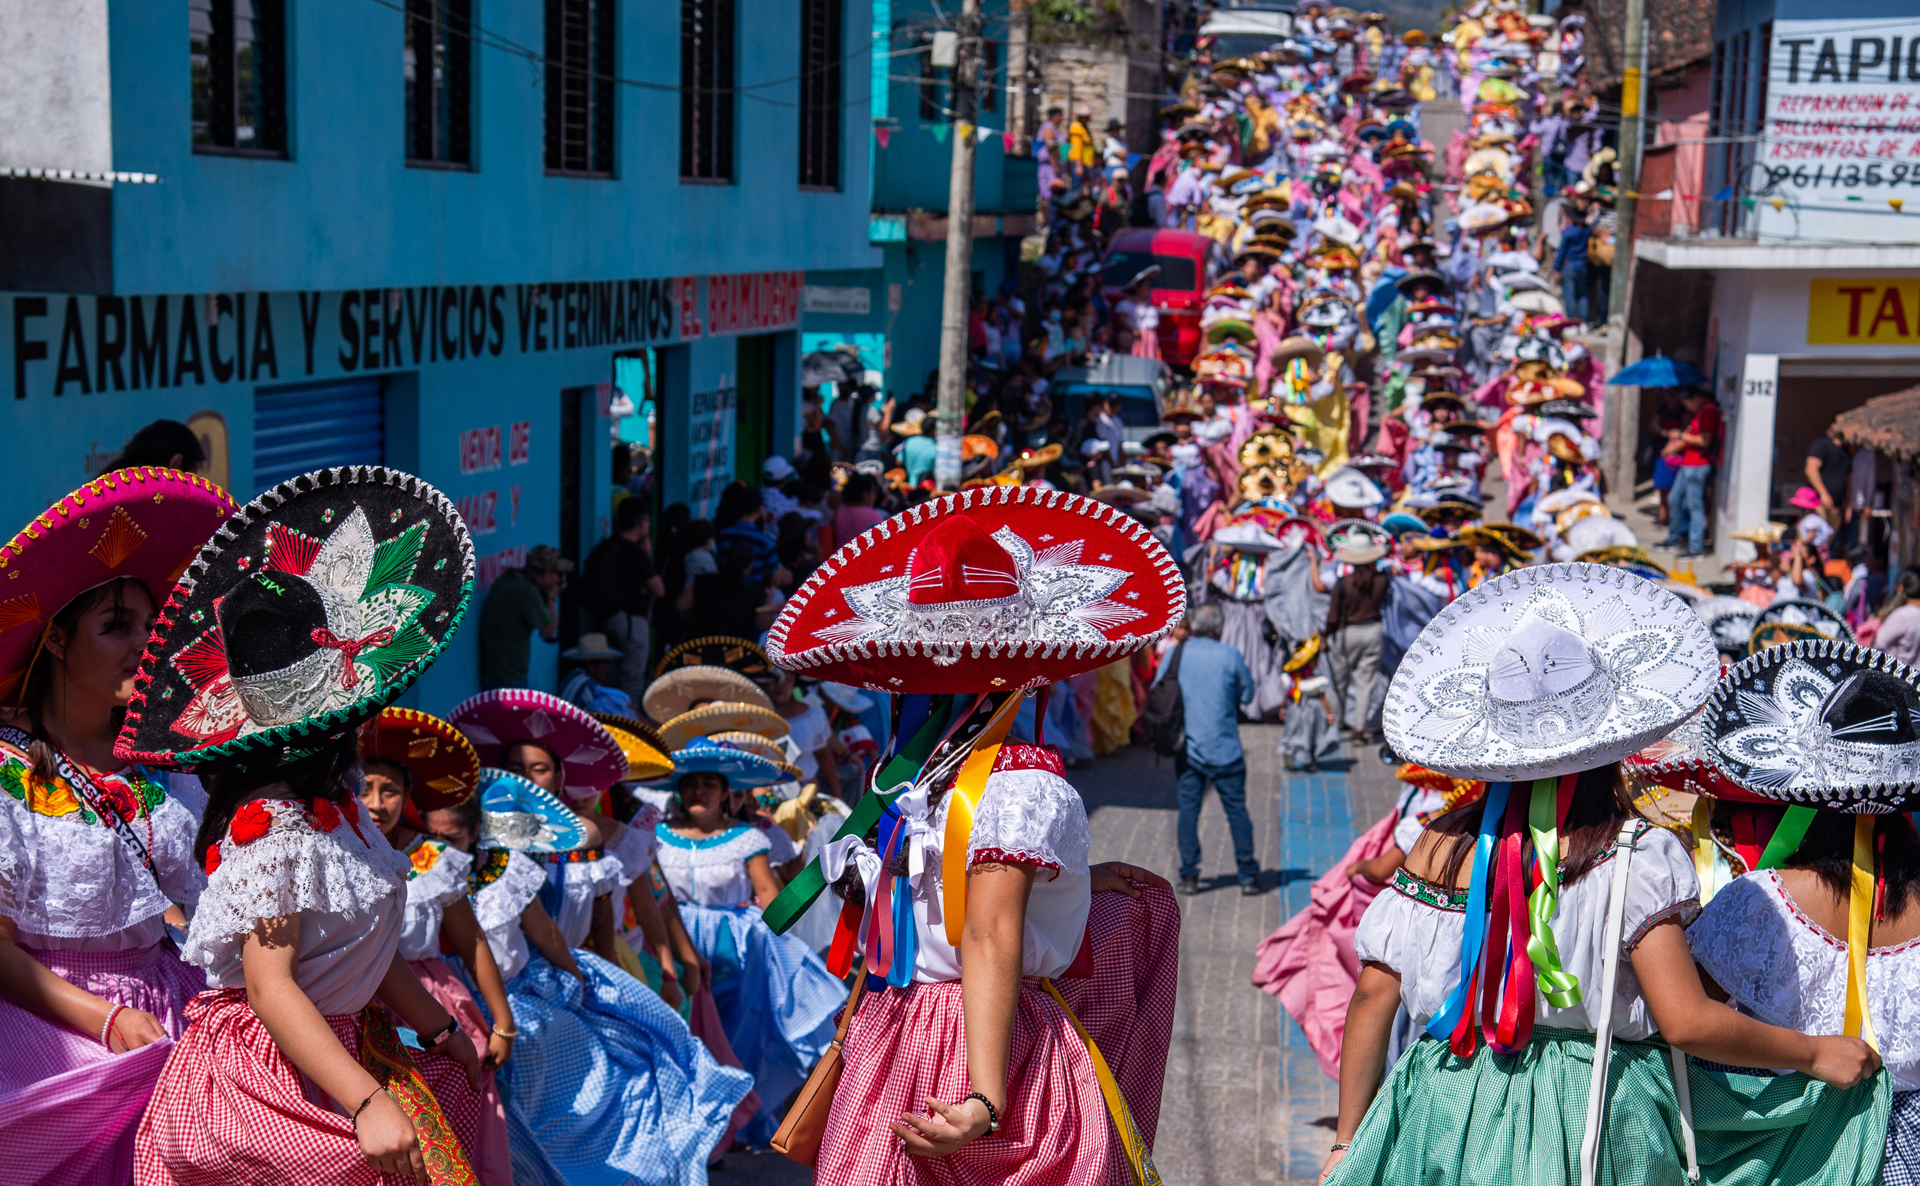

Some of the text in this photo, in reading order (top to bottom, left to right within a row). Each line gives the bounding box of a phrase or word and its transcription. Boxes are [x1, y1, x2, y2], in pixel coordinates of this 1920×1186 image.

[1769, 138, 1871, 159] ASIENTOS
[1837, 286, 1920, 338] TA
[13, 291, 279, 400] FARMACIA
[299, 290, 321, 375] Y
[337, 283, 505, 373] SERVICIOS
[516, 277, 674, 353] VETERINARIOS
[1745, 379, 1773, 396] 312
[459, 420, 532, 475] VENTA DE
[510, 484, 523, 527] Y
